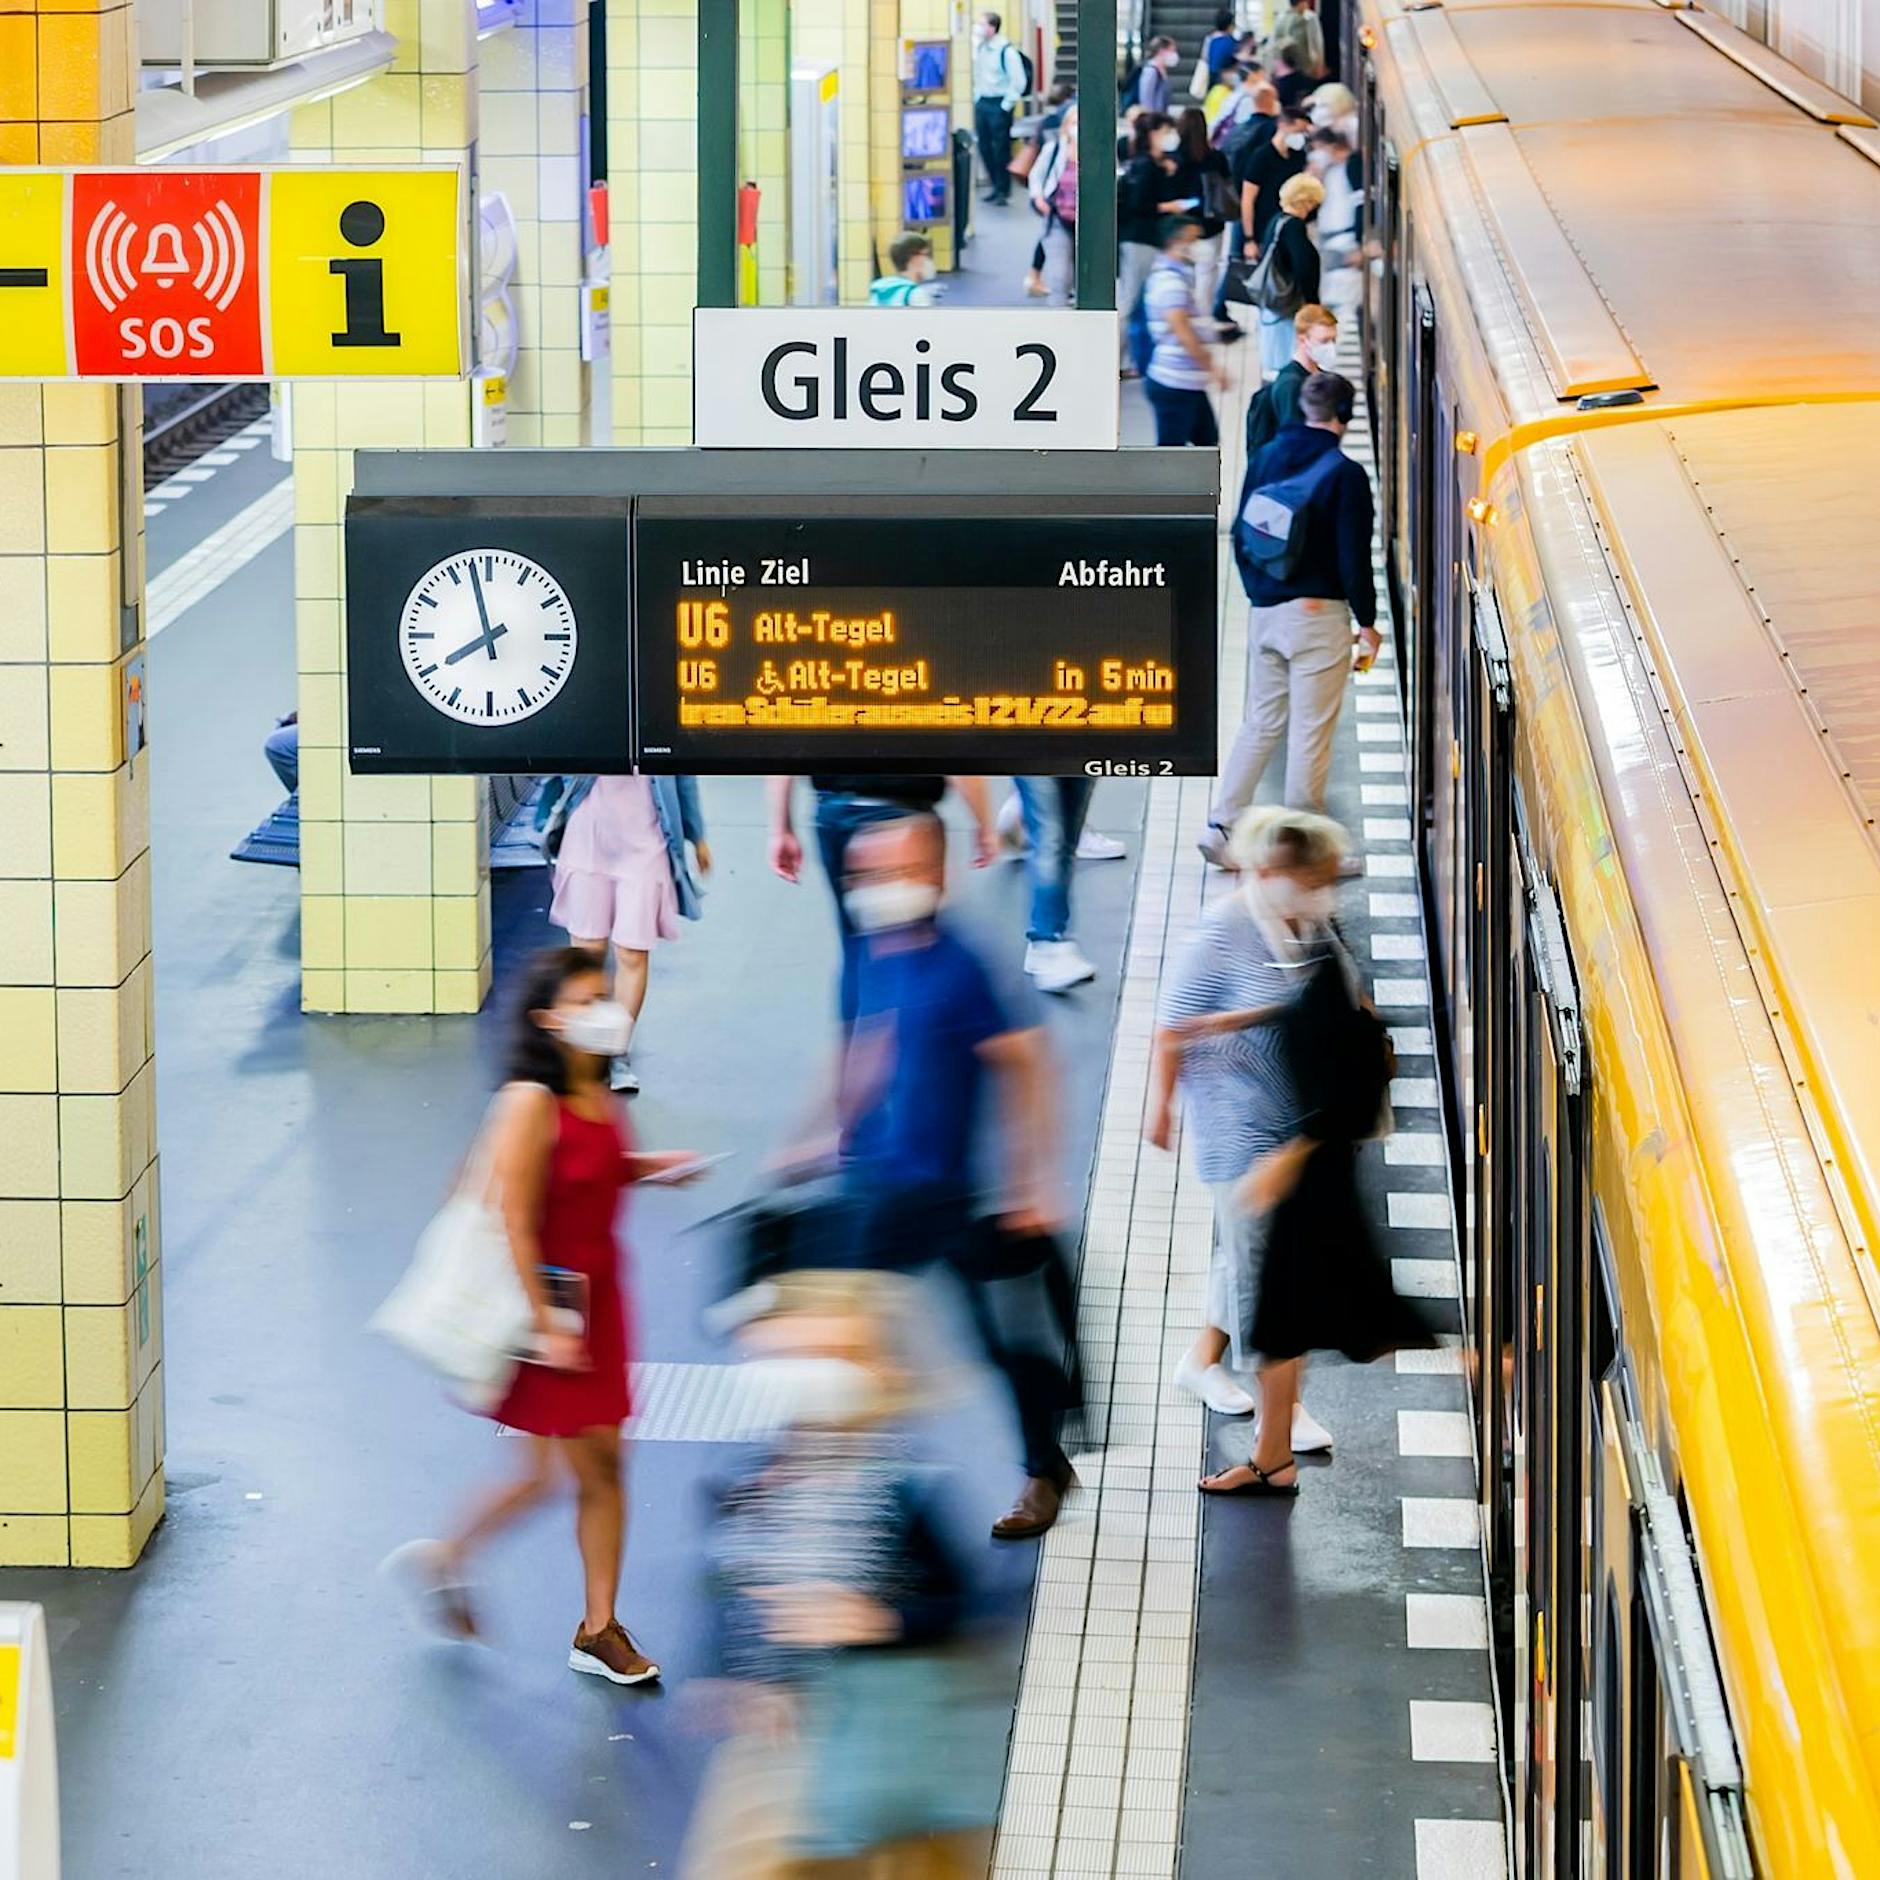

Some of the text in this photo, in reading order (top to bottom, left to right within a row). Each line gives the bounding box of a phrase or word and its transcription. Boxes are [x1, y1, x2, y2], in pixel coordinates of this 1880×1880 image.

[120, 316, 214, 359] SOS
[761, 337, 1058, 422] Gleis 2
[681, 559, 809, 587] Linie Ziel
[1058, 559, 1165, 587] Abfahrt
[677, 602, 895, 649] U6 Alt-Tegel
[679, 660, 1174, 694] U6 Alt-Tegel in 5 min
[1084, 759, 1174, 776] Gleis 2
